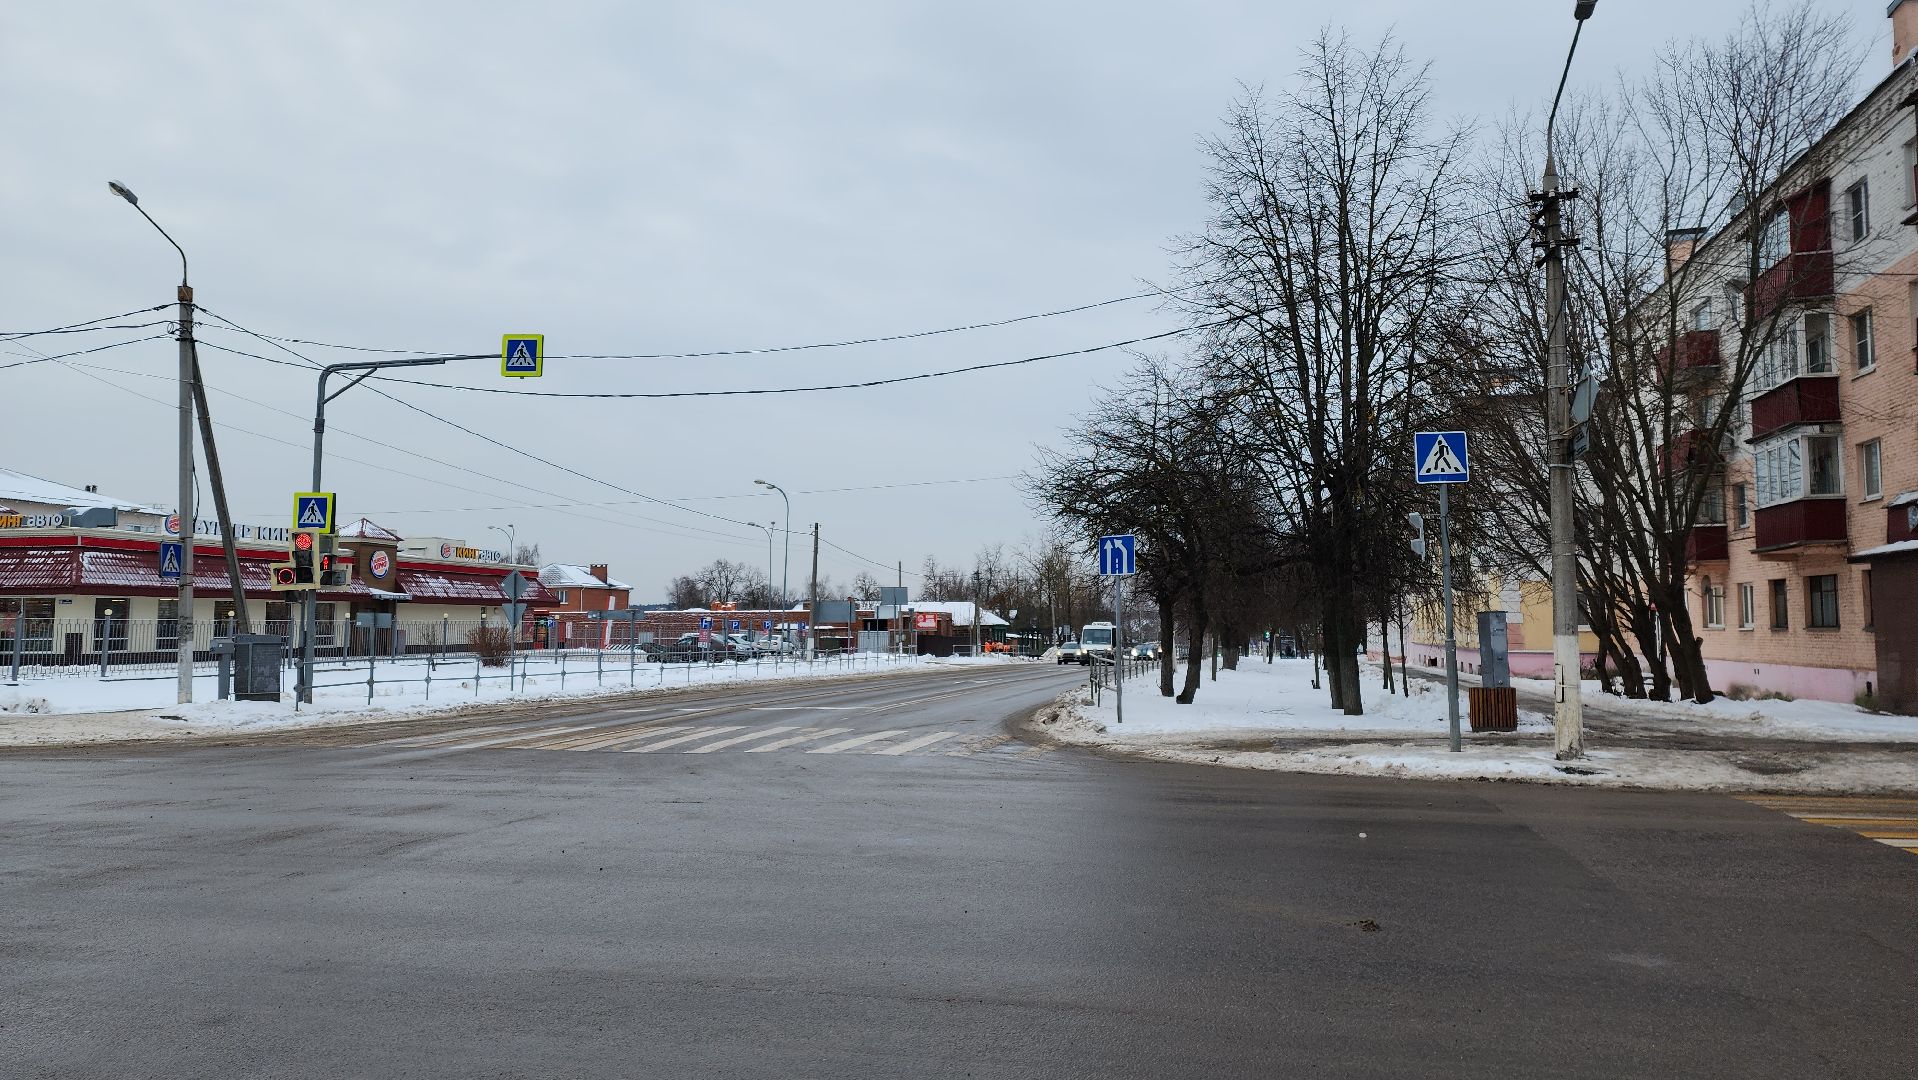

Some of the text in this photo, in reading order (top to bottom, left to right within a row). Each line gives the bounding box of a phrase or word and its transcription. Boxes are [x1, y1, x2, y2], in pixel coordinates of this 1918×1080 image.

[0, 514, 64, 528] ИНГ авто
[193, 520, 252, 538] БУЕР
[257, 526, 289, 541] КИН
